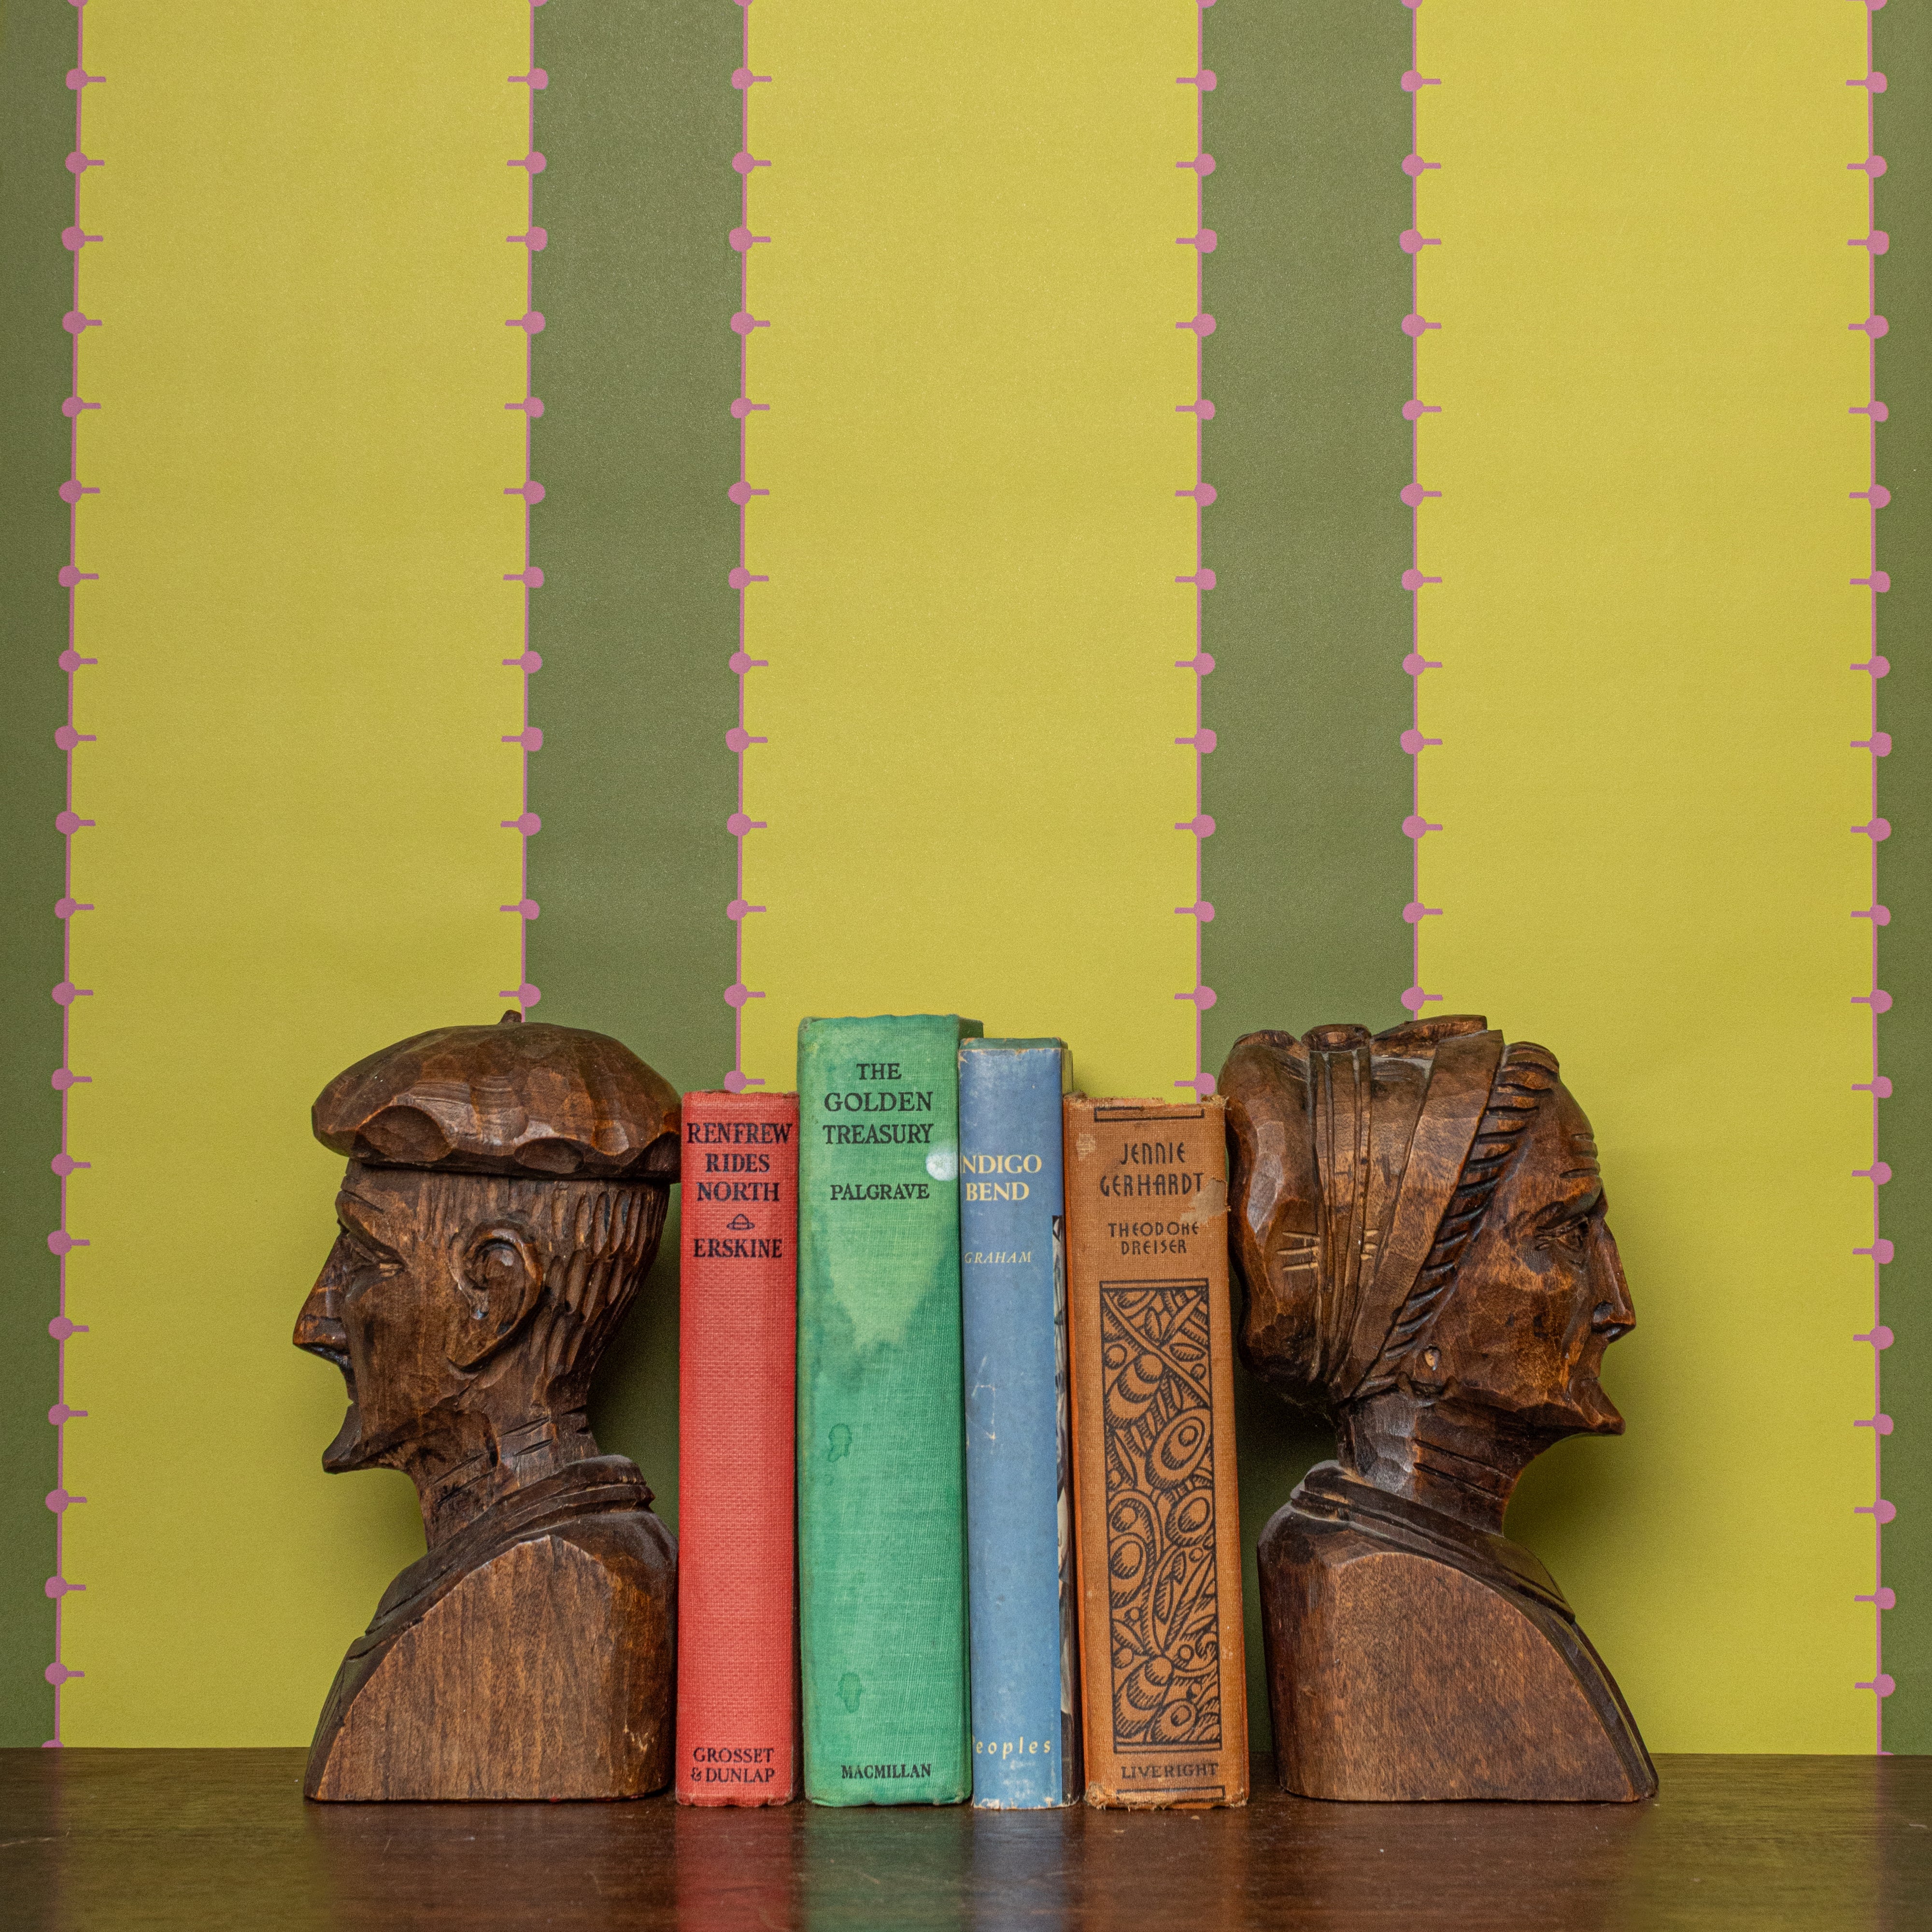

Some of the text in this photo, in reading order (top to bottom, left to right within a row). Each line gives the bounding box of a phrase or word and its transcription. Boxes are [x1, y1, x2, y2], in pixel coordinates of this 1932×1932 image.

[857, 1063, 902, 1080] THE
[824, 1092, 933, 1111] GOLDEN
[687, 1123, 793, 1144] RENFREW
[823, 1123, 934, 1144] TREASURY
[705, 1153, 770, 1173] RIDES
[1120, 1142, 1185, 1165] JENNIE
[696, 1182, 780, 1201] NORTH
[830, 1183, 930, 1200] PALGRAVE
[966, 1182, 1029, 1201] BEND
[1100, 1173, 1204, 1197] GERHARDT
[693, 1238, 783, 1259] ERSKINE
[1121, 1239, 1187, 1255] DREISER
[965, 1251, 1032, 1264] GRAHAM
[692, 1747, 773, 1763] GROSSET
[972, 1735, 1051, 1760] eoples
[691, 1768, 775, 1783] & DUNLAP
[841, 1763, 932, 1779] MACMILLAN
[1121, 1763, 1219, 1779] LIVERIGHT
